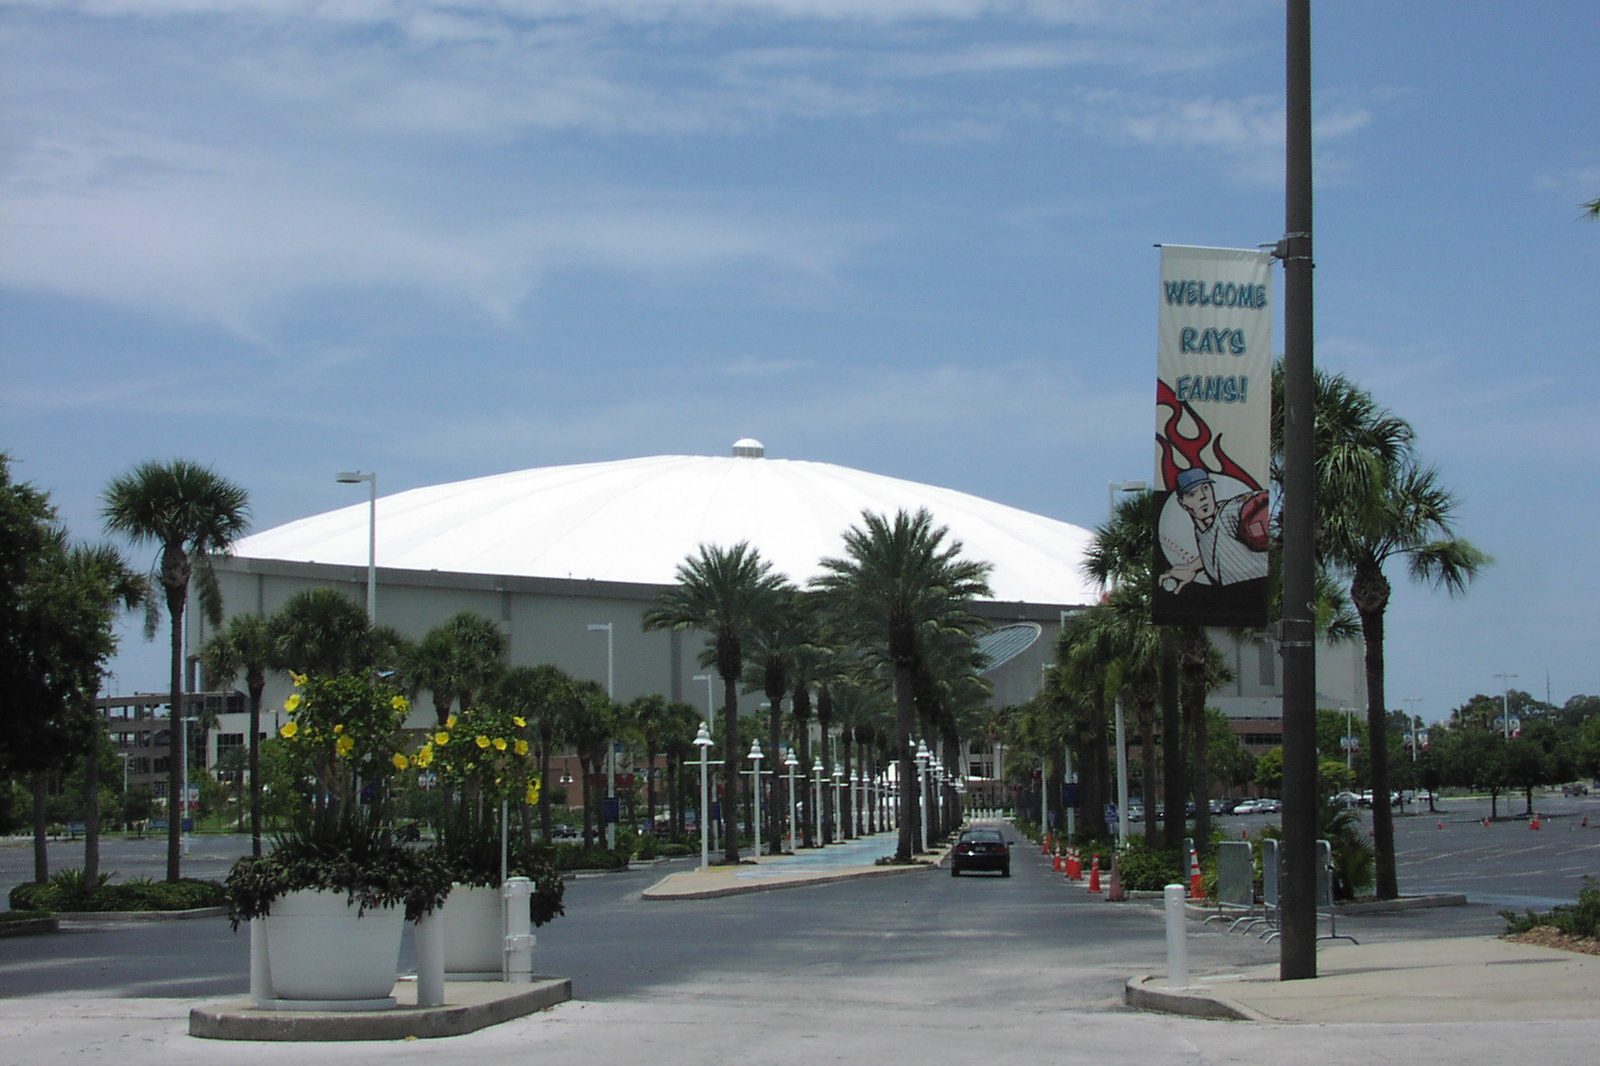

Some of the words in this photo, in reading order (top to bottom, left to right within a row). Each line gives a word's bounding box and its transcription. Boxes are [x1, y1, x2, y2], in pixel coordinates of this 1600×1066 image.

[1164, 279, 1267, 309] WELCOME
[1180, 326, 1246, 356] RAYS
[1176, 374, 1248, 403] FANS!
